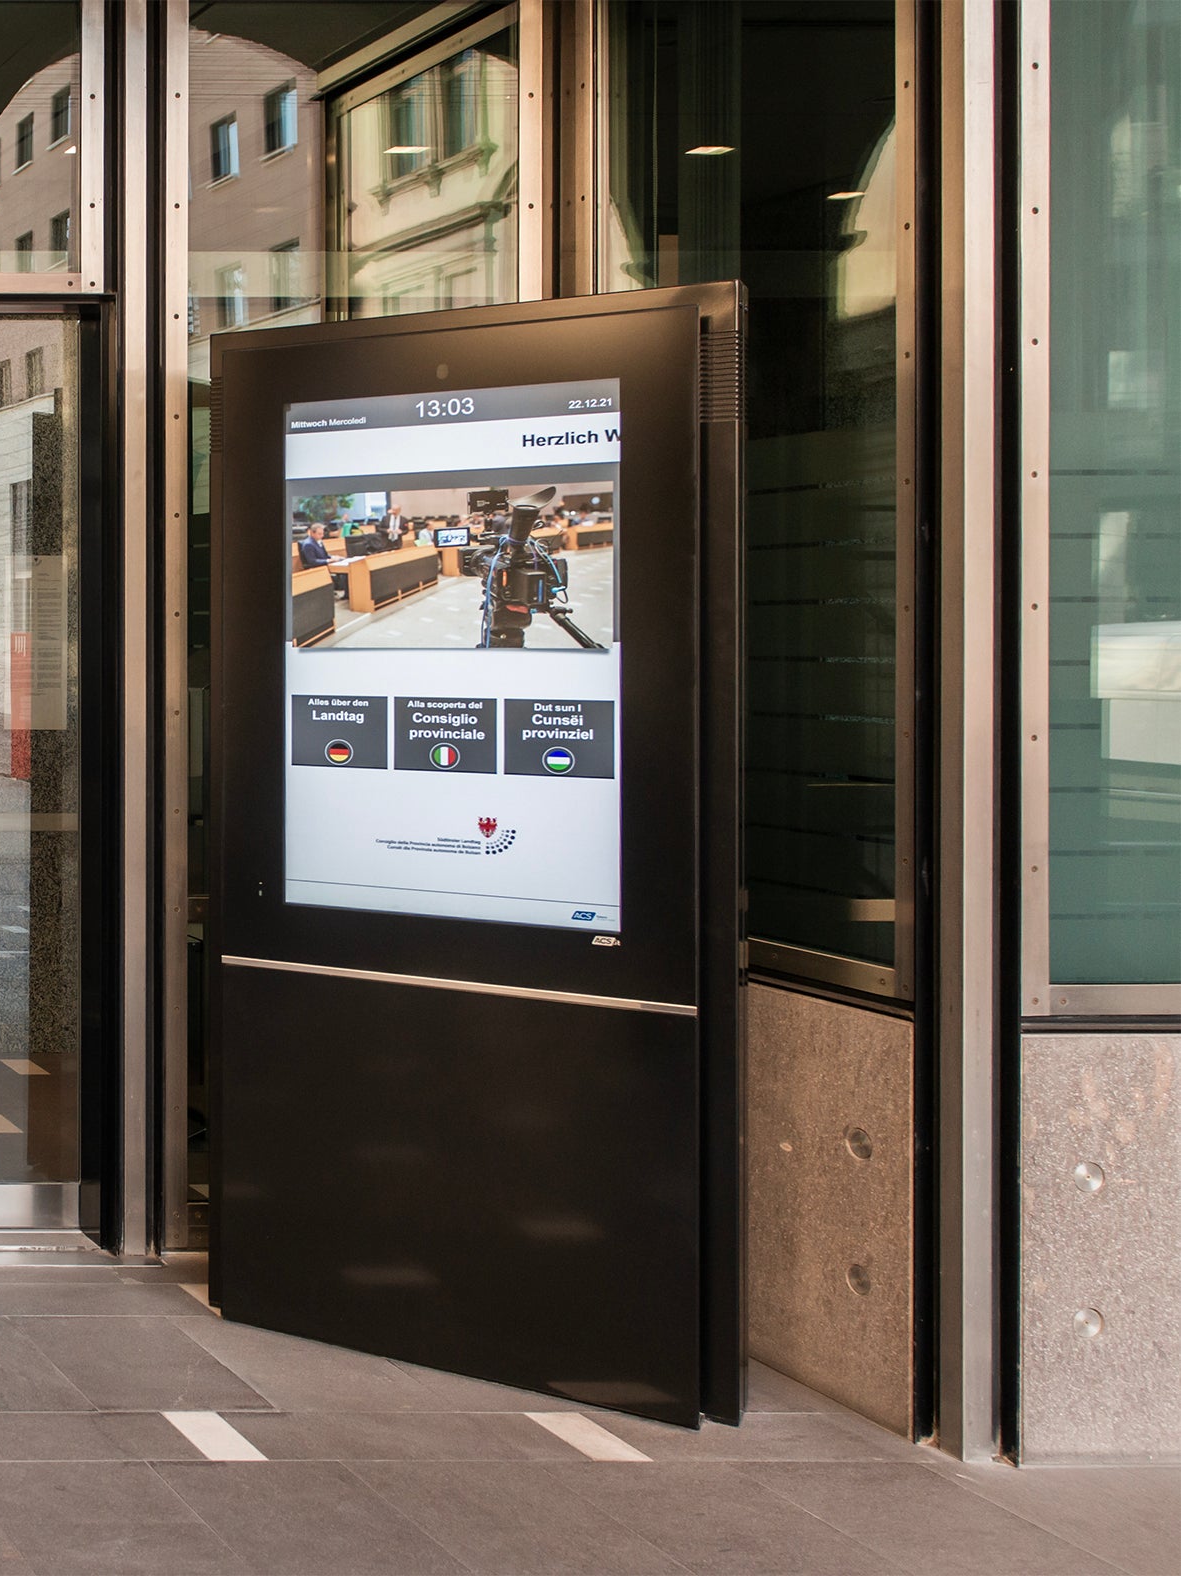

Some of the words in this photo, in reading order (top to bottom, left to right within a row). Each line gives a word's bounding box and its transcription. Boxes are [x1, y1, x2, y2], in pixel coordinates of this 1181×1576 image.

[415, 397, 475, 418] 13:03
[568, 398, 613, 409] 22.12.21
[291, 419, 328, 429] Mittwoch
[522, 431, 599, 448] Herzlich
[308, 698, 330, 706] Alles
[331, 698, 351, 706] über
[352, 699, 369, 707] den
[407, 700, 426, 708] Alla
[426, 701, 466, 710] scoperta
[467, 701, 483, 709] del
[533, 703, 553, 712] Dut
[554, 704, 575, 712] sun
[312, 710, 365, 724] Landtag
[412, 712, 479, 727] Consiglio
[531, 713, 584, 726] Cunsëi
[409, 727, 486, 740] provinciale
[522, 728, 594, 741] provinziel
[573, 912, 592, 920] ACS
[594, 937, 612, 945] ACS
